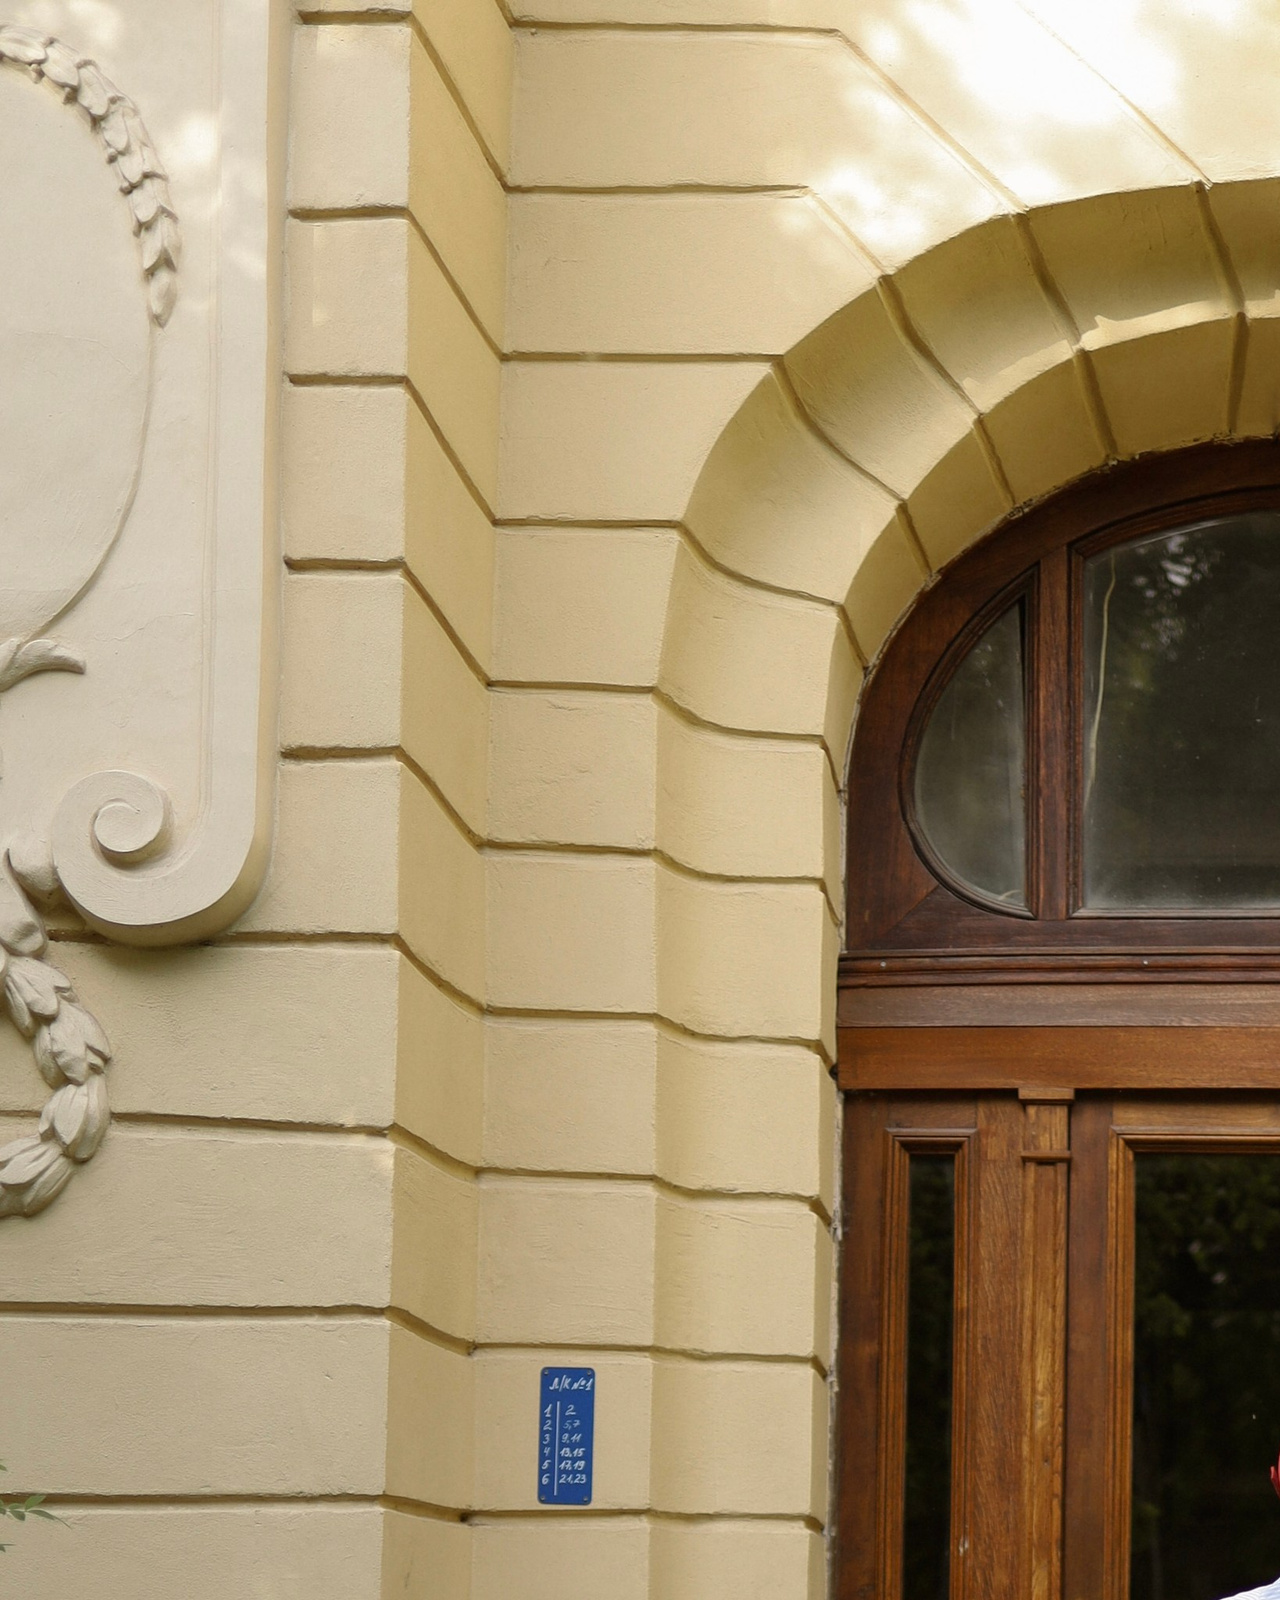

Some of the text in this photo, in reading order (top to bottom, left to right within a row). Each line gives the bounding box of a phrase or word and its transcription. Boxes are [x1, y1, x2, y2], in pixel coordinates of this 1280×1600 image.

[544, 1404, 576, 1417] 1 2
[543, 1419, 552, 1431] 2
[543, 1434, 550, 1444] 3
[544, 1447, 550, 1457] 4
[542, 1460, 551, 1469] 5
[542, 1473, 550, 1485] 6
